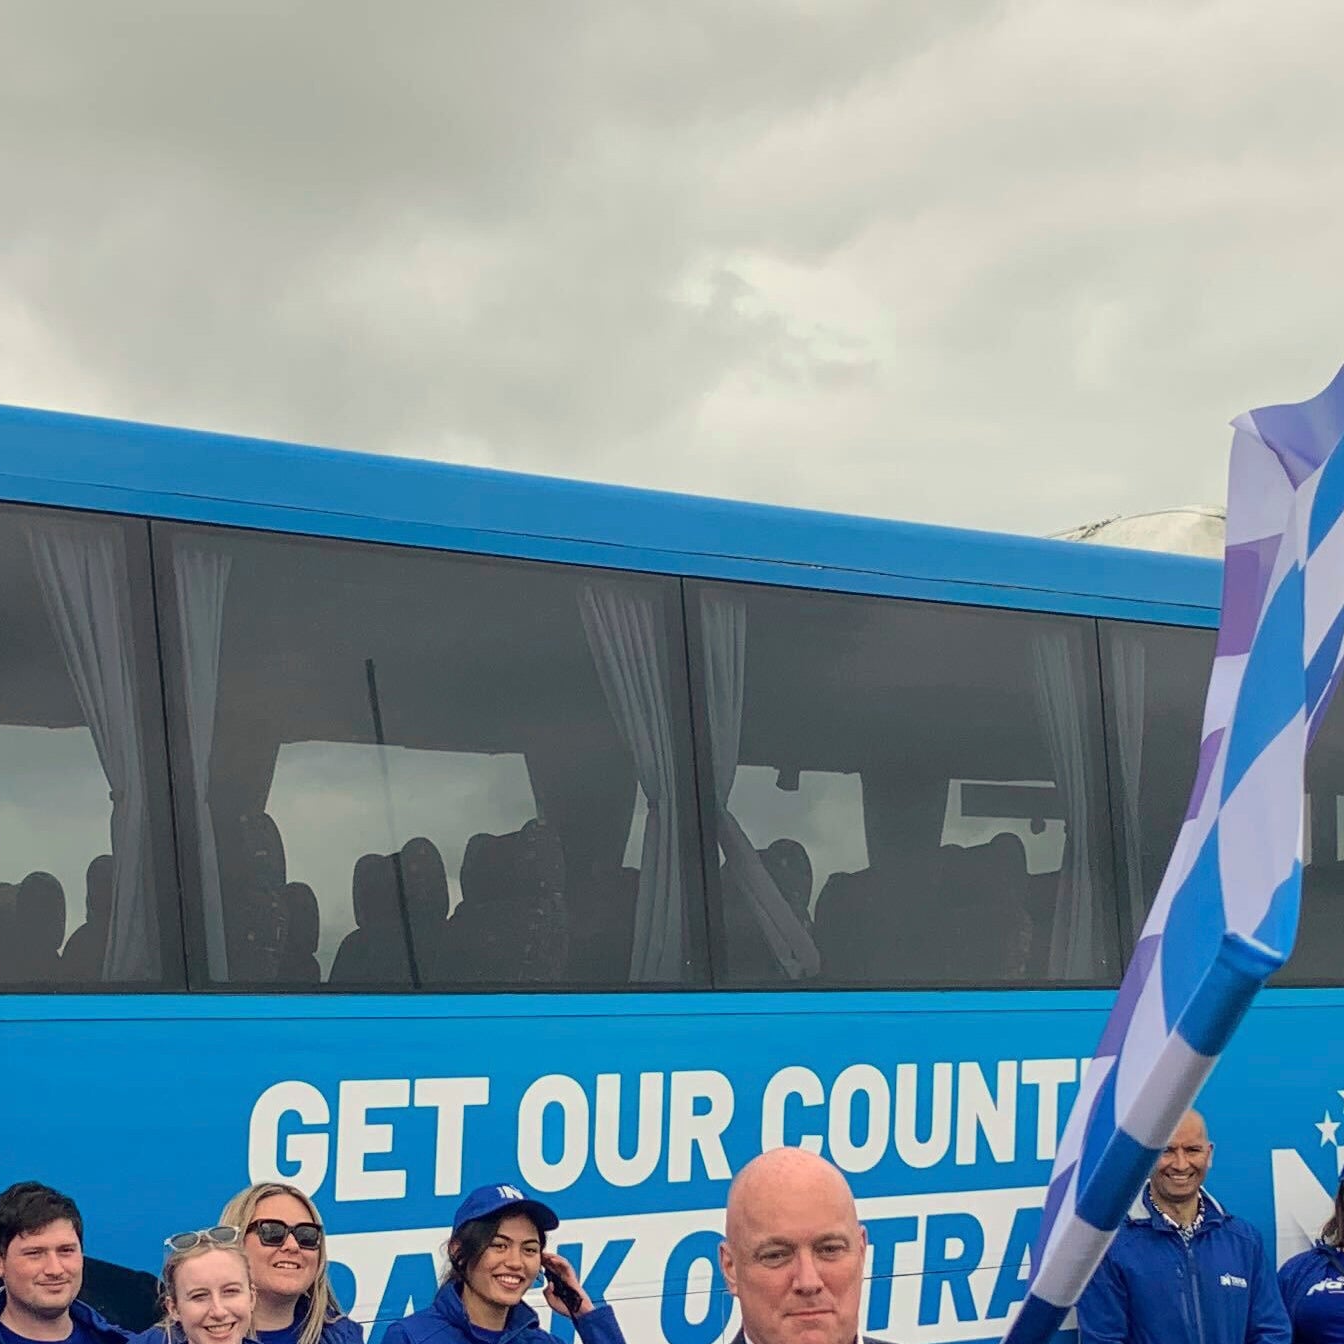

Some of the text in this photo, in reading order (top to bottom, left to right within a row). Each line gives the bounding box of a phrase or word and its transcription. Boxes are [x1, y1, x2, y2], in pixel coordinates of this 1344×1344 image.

[248, 1057, 1092, 1202] GET OUR COUNT
[859, 1206, 1044, 1332] TRA
